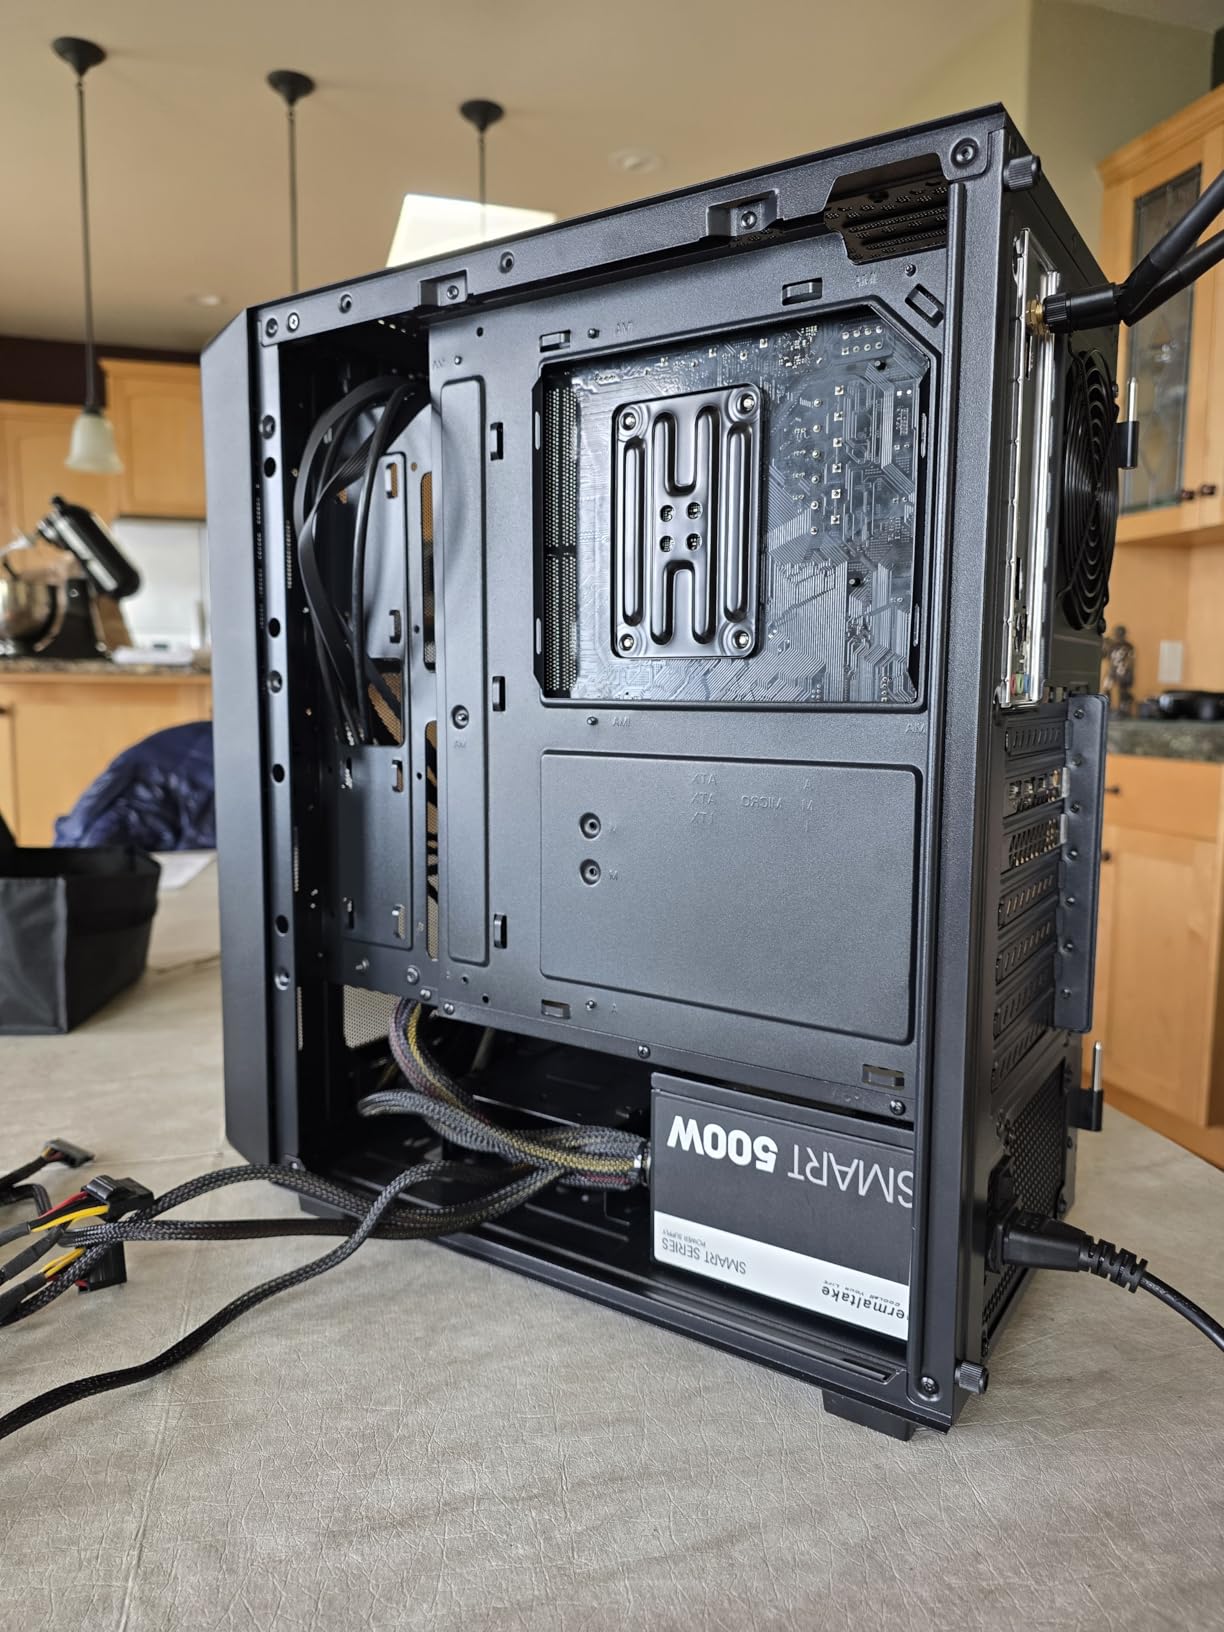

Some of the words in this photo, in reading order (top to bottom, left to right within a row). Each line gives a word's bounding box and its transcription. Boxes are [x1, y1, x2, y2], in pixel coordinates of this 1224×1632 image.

[666, 1115, 779, 1174] 500W
[787, 1143, 914, 1209] SMART
[662, 1237, 701, 1260] SERIES
[704, 1250, 747, 1275] SMART
[821, 1286, 909, 1320] ermaltake
